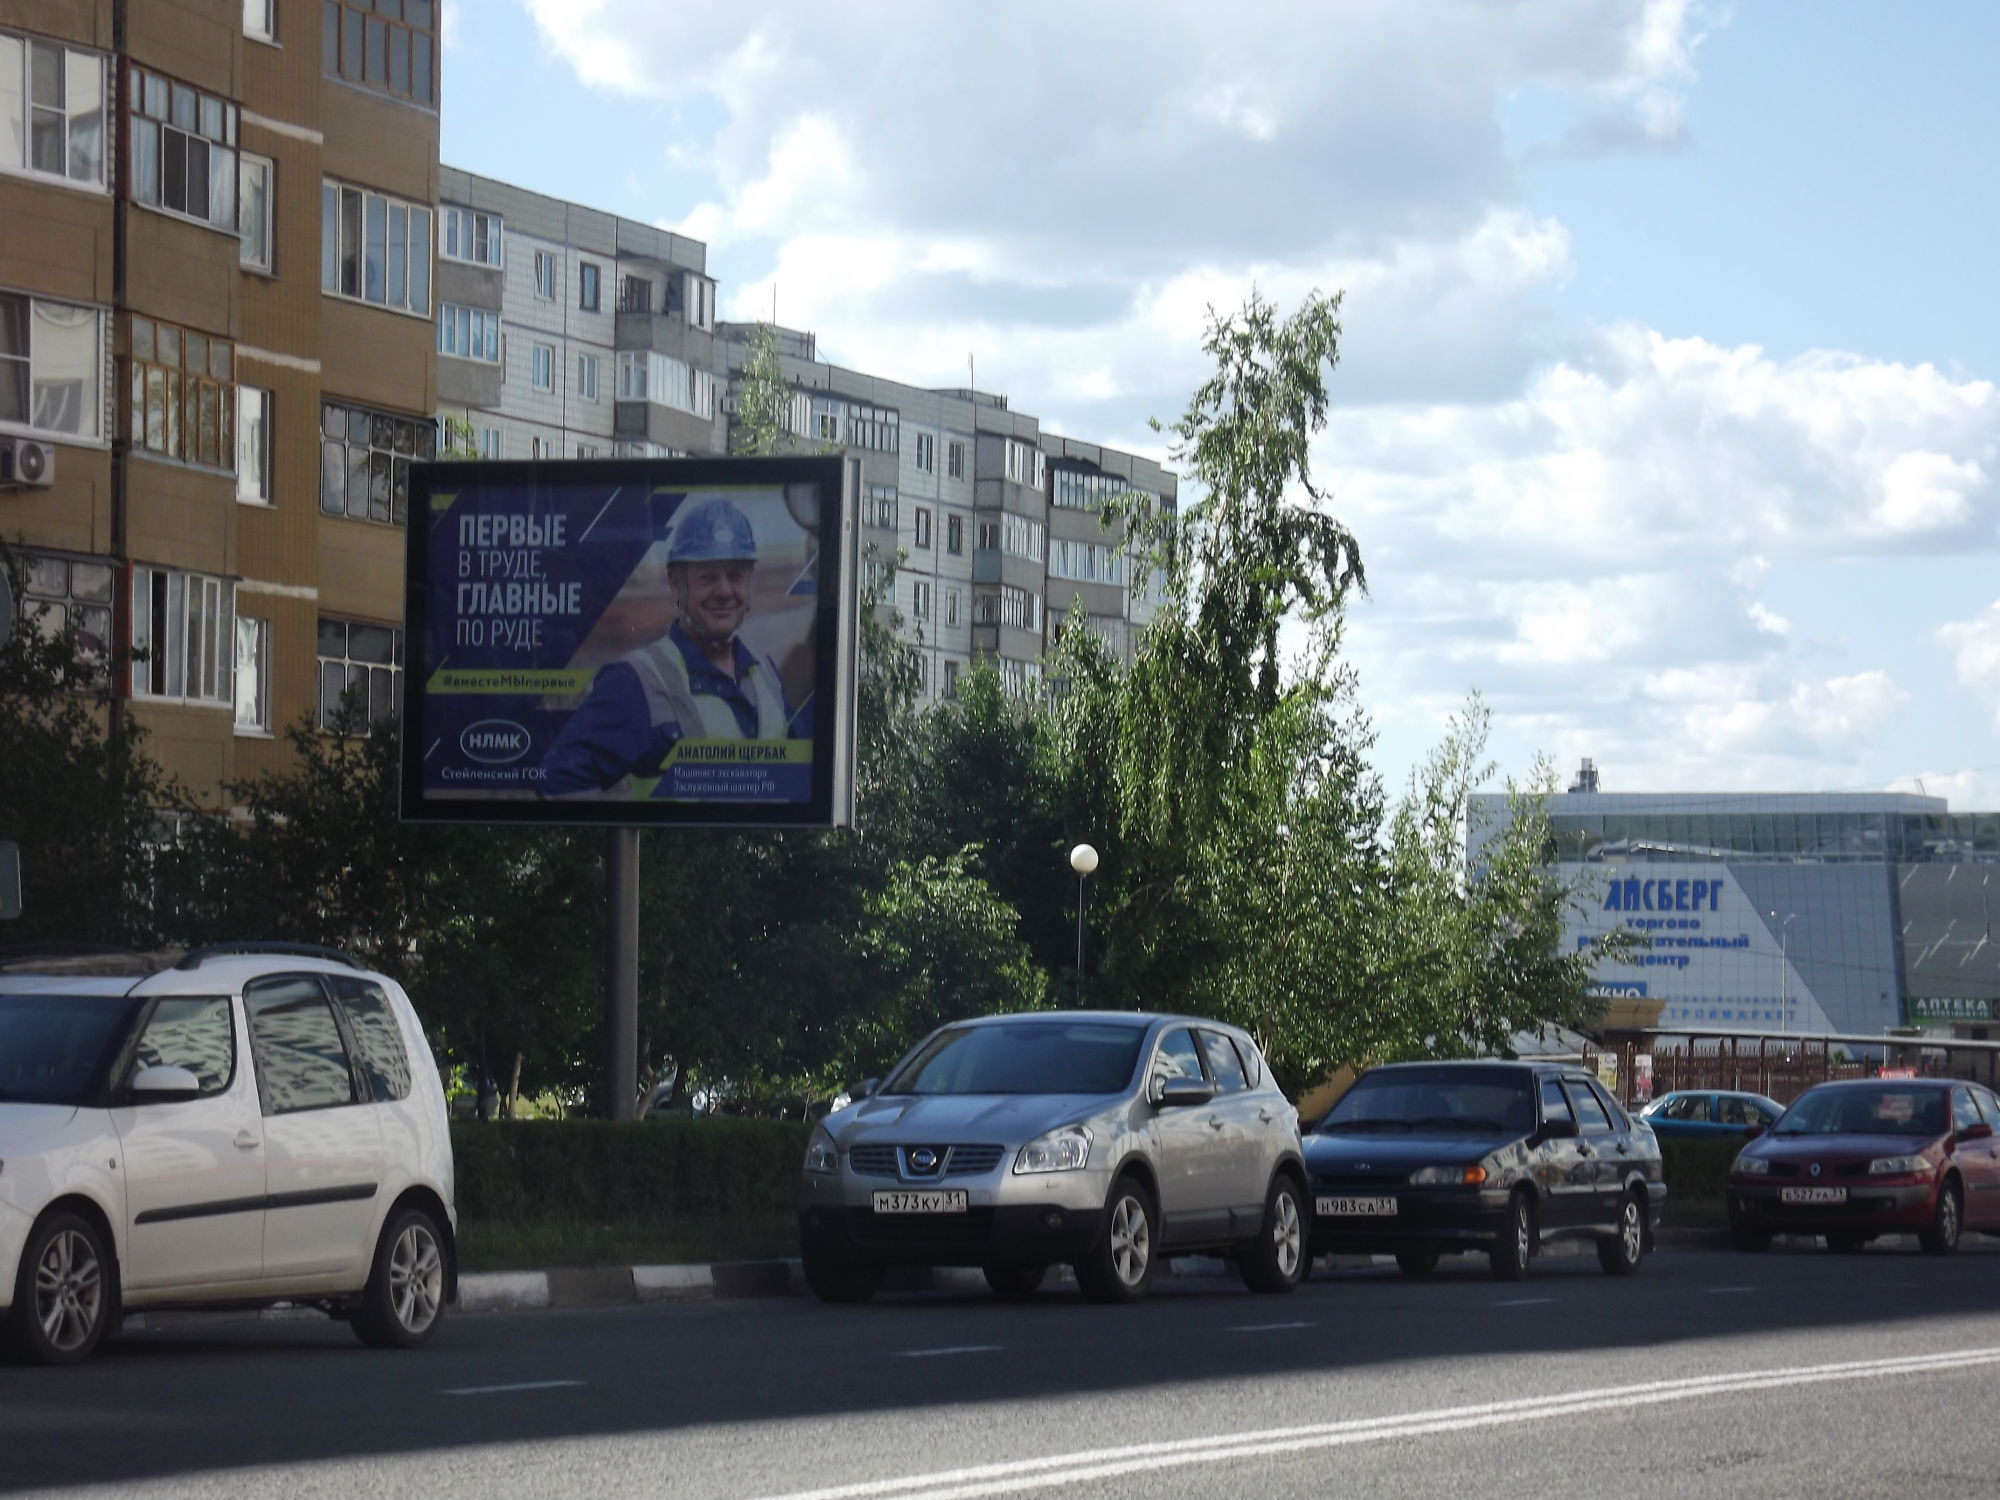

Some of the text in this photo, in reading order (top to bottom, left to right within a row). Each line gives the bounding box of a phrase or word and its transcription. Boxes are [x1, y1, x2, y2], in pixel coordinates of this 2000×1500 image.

[459, 514, 566, 547] ПЕРВЫЕ
[458, 550, 546, 581] В ТРУДЕ,
[457, 582, 582, 615] ГЛАВНЫЕ
[457, 619, 543, 652] ПО РУДЕ
[442, 676, 575, 689] #вместеМЫпервые
[469, 733, 521, 749] НЛМК
[677, 744, 787, 762] АНАТОЛИЙ ЩЕРБАК
[441, 767, 547, 780] Стойленский ГОК
[1603, 874, 1723, 912] АЙСБЕРГ
[1626, 918, 1701, 929] торгово
[1917, 998, 1987, 1010] АПТЕКА
[1659, 1007, 1796, 1021] ТРОЙМАРКЕТ
[879, 1192, 962, 1211] М373КУ 31
[1321, 1198, 1393, 1213] Н983СА 31
